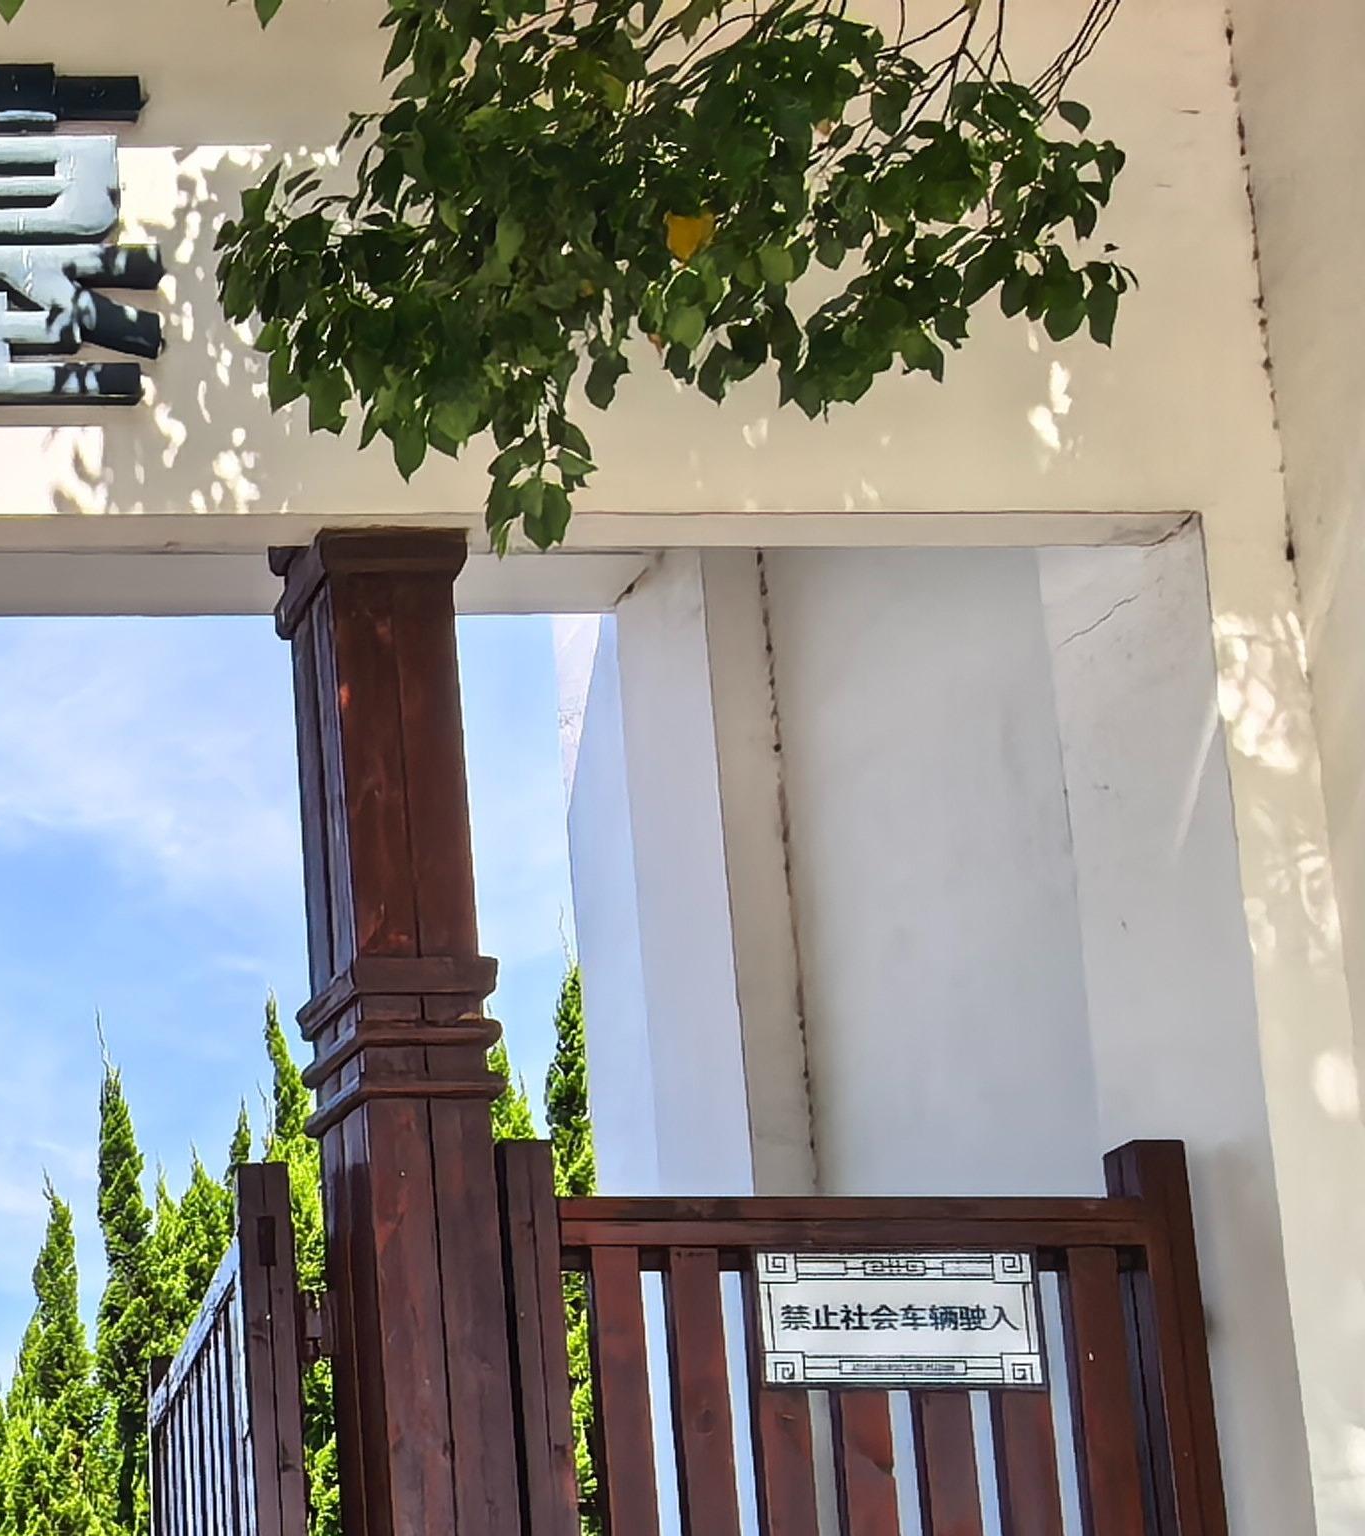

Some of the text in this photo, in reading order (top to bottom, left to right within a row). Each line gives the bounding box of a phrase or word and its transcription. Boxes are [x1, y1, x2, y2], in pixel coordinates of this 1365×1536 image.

[780, 1303, 1020, 1332] 禁止社会车辆驶入
